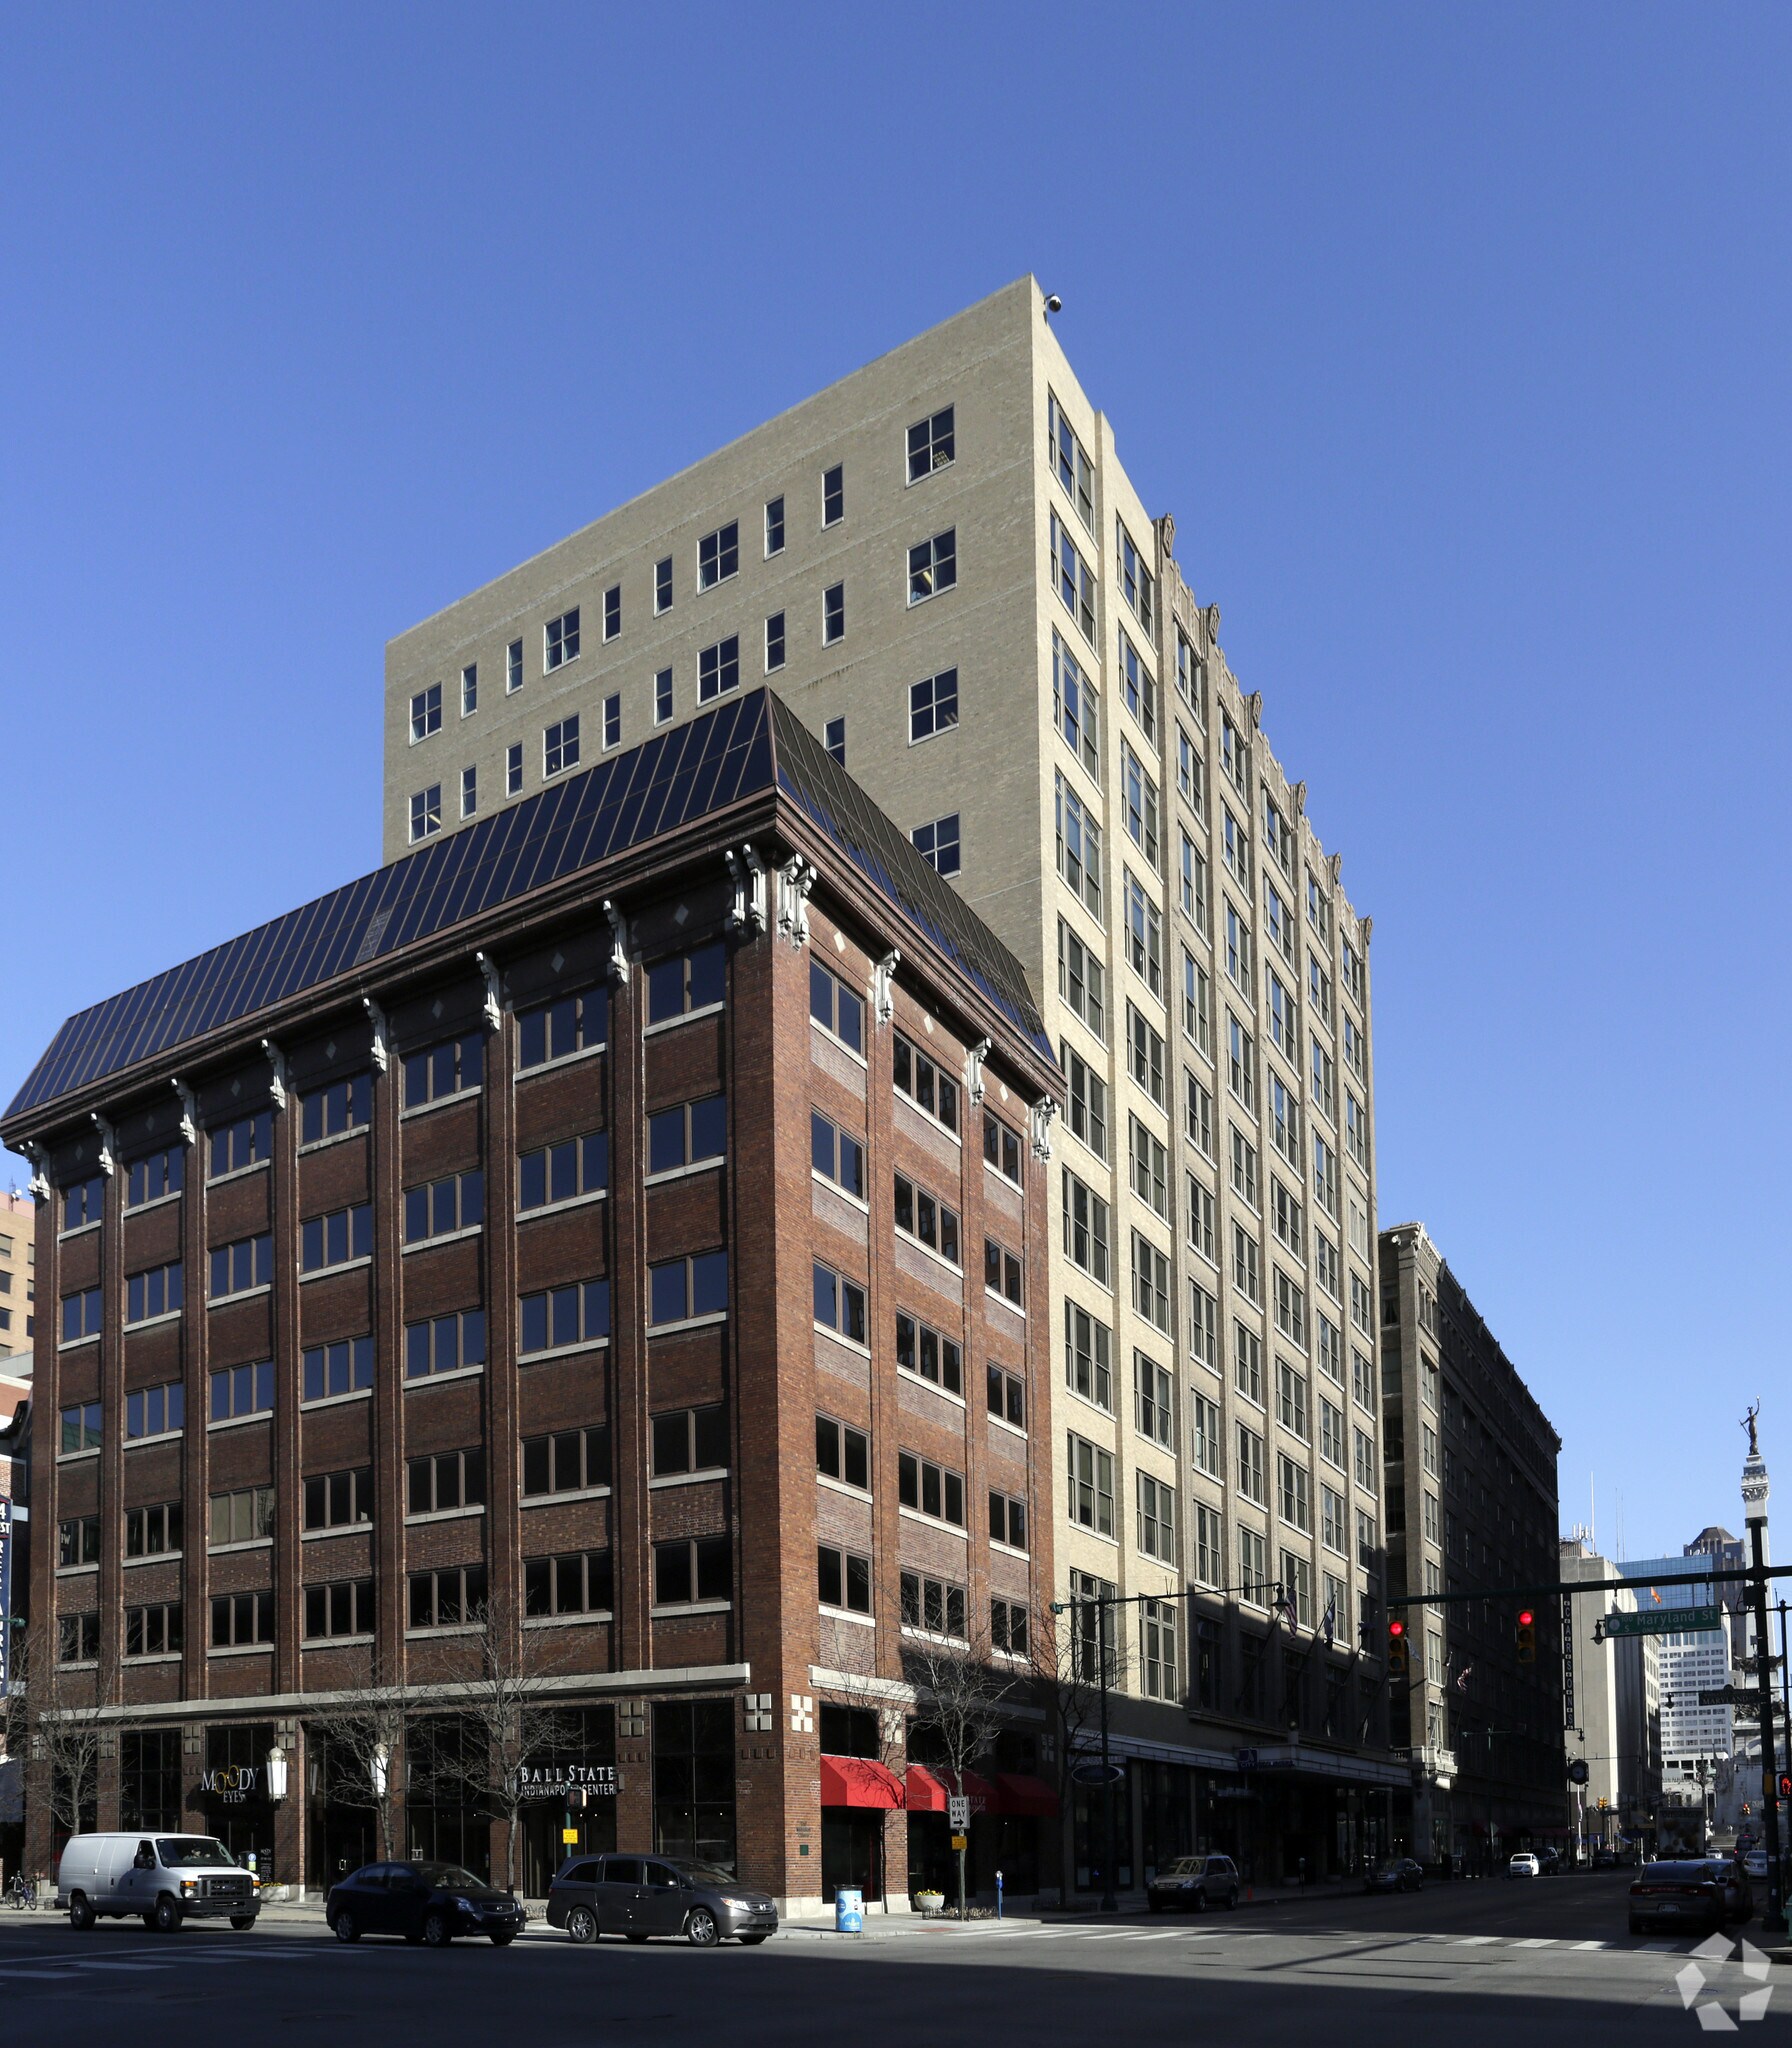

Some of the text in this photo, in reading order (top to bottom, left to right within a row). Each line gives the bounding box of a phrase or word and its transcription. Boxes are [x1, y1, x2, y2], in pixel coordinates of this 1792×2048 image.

[1621, 1609, 1714, 1626] 100 Maryland St
[1624, 1625, 1630, 1633] S
[1564, 1606, 1573, 1724] CARSONS
[1702, 1695, 1748, 1705] MARYLAND
[201, 1765, 259, 1794] MOODY
[521, 1765, 614, 1783] BALL STATE
[223, 1790, 244, 1803] EYES
[521, 1784, 614, 1796] INDIANAPO CENTER
[952, 1800, 965, 1808] ONE
